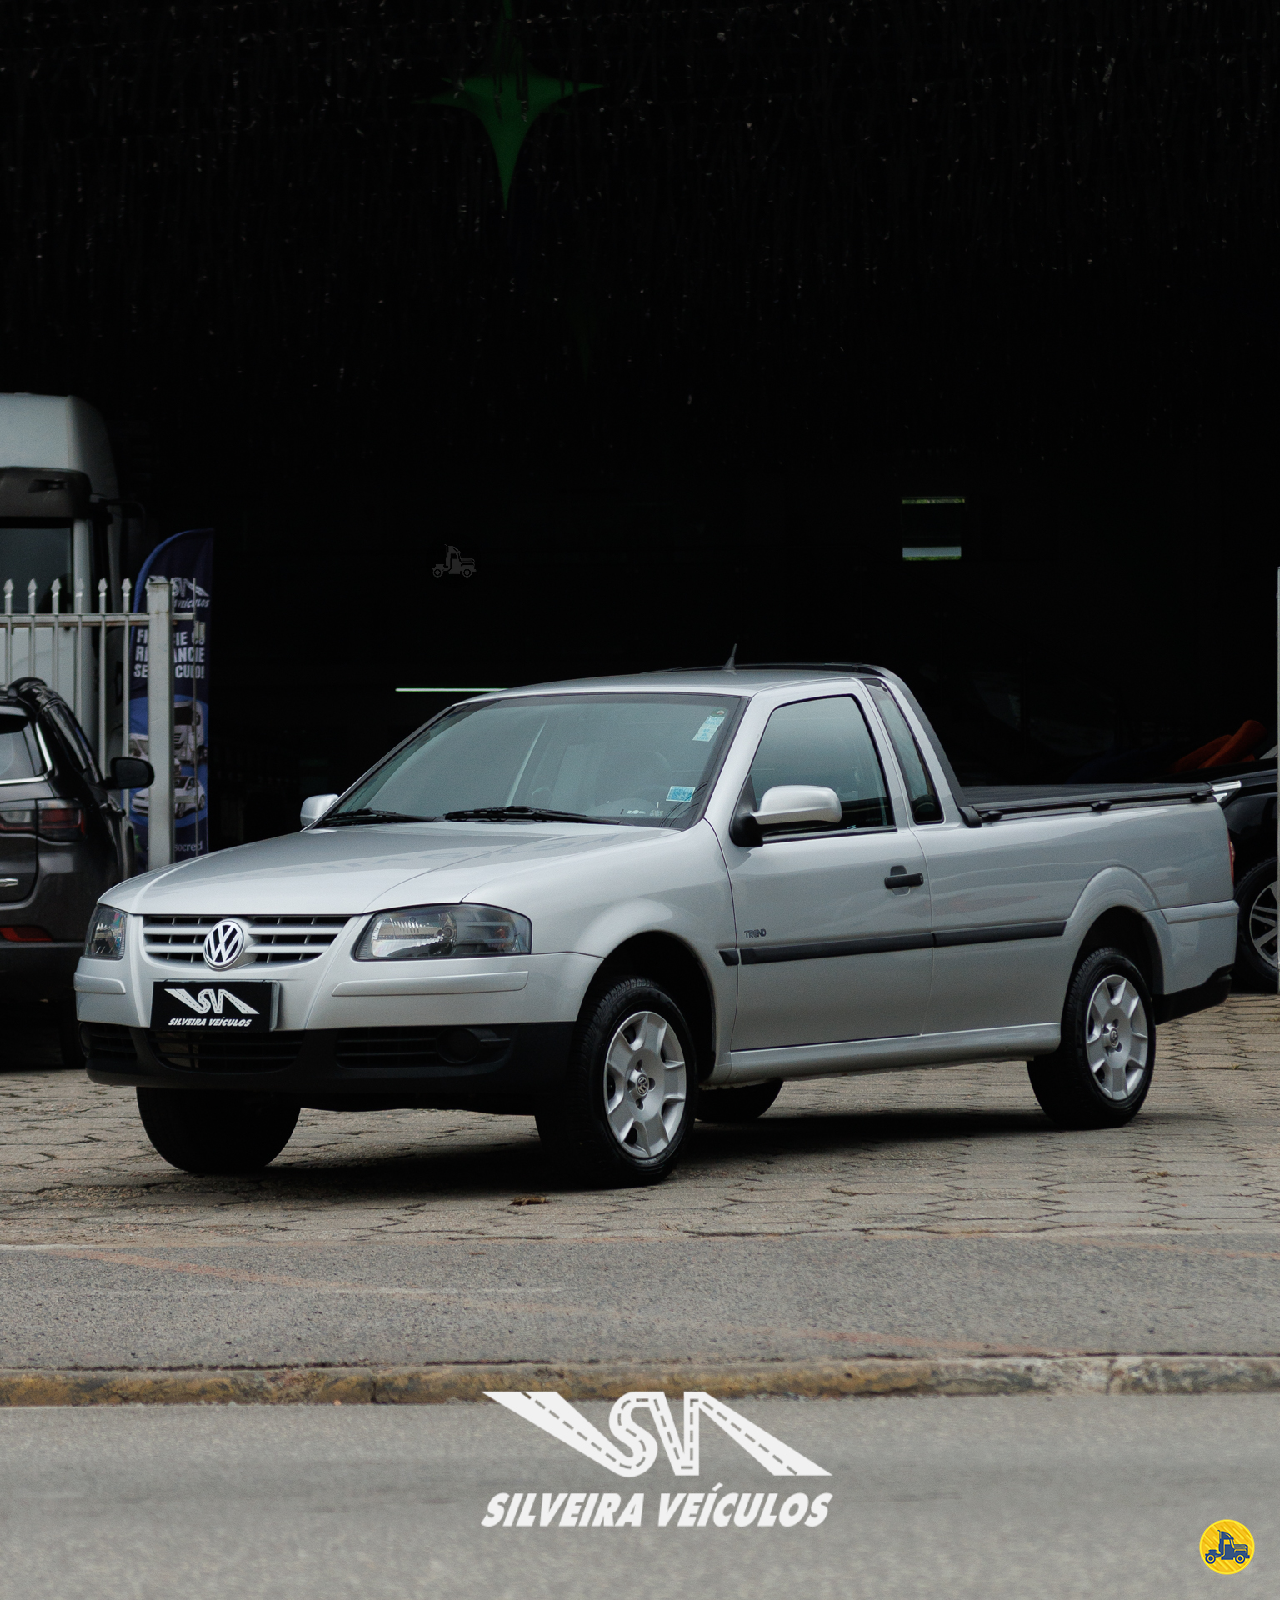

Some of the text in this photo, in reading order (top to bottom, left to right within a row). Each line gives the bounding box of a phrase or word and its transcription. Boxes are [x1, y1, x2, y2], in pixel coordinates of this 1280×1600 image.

[744, 928, 767, 938] TREND
[168, 1017, 252, 1027] SILVEIRA VEÍCULOS
